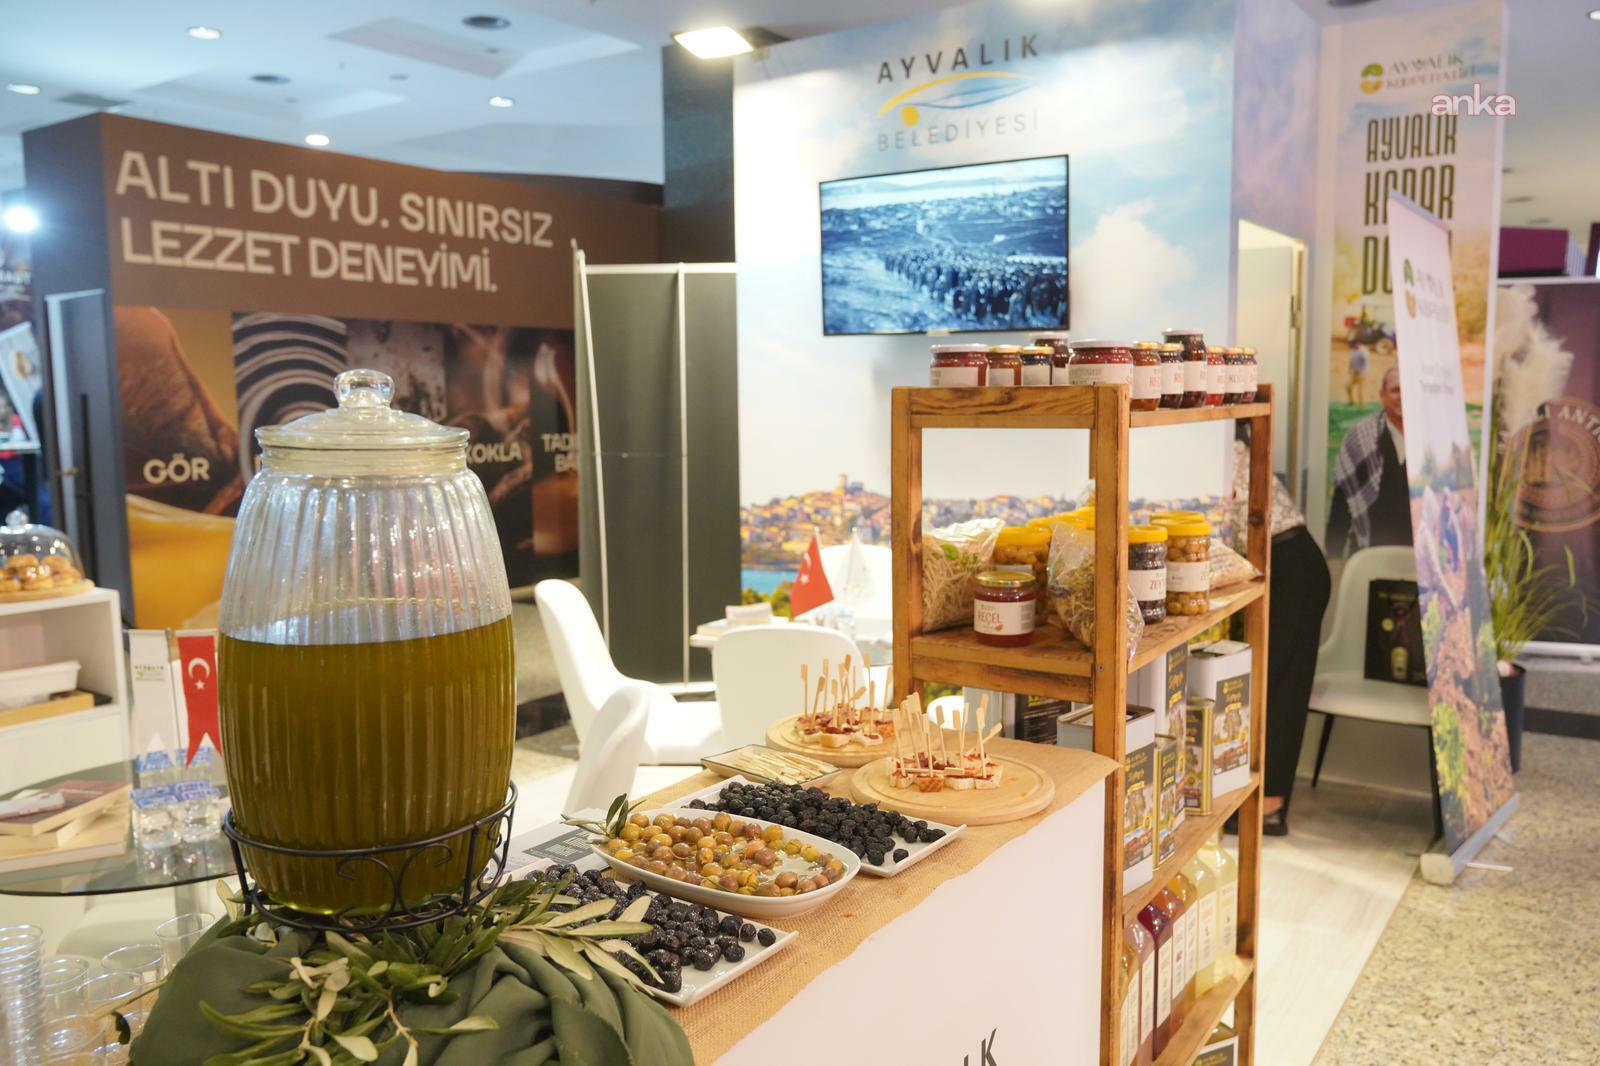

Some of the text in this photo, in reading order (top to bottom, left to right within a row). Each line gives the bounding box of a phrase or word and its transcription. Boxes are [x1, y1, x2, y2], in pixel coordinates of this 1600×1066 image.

[877, 34, 1039, 84] AYVALIK
[877, 109, 1039, 152] BELEDİYESİ
[1366, 112, 1457, 163] AYVALIK
[115, 150, 553, 248] ALTI DUYU. SINIRSIZ
[121, 218, 498, 293] LEZZET DENEYİMİ.
[143, 454, 210, 484] GÖR
